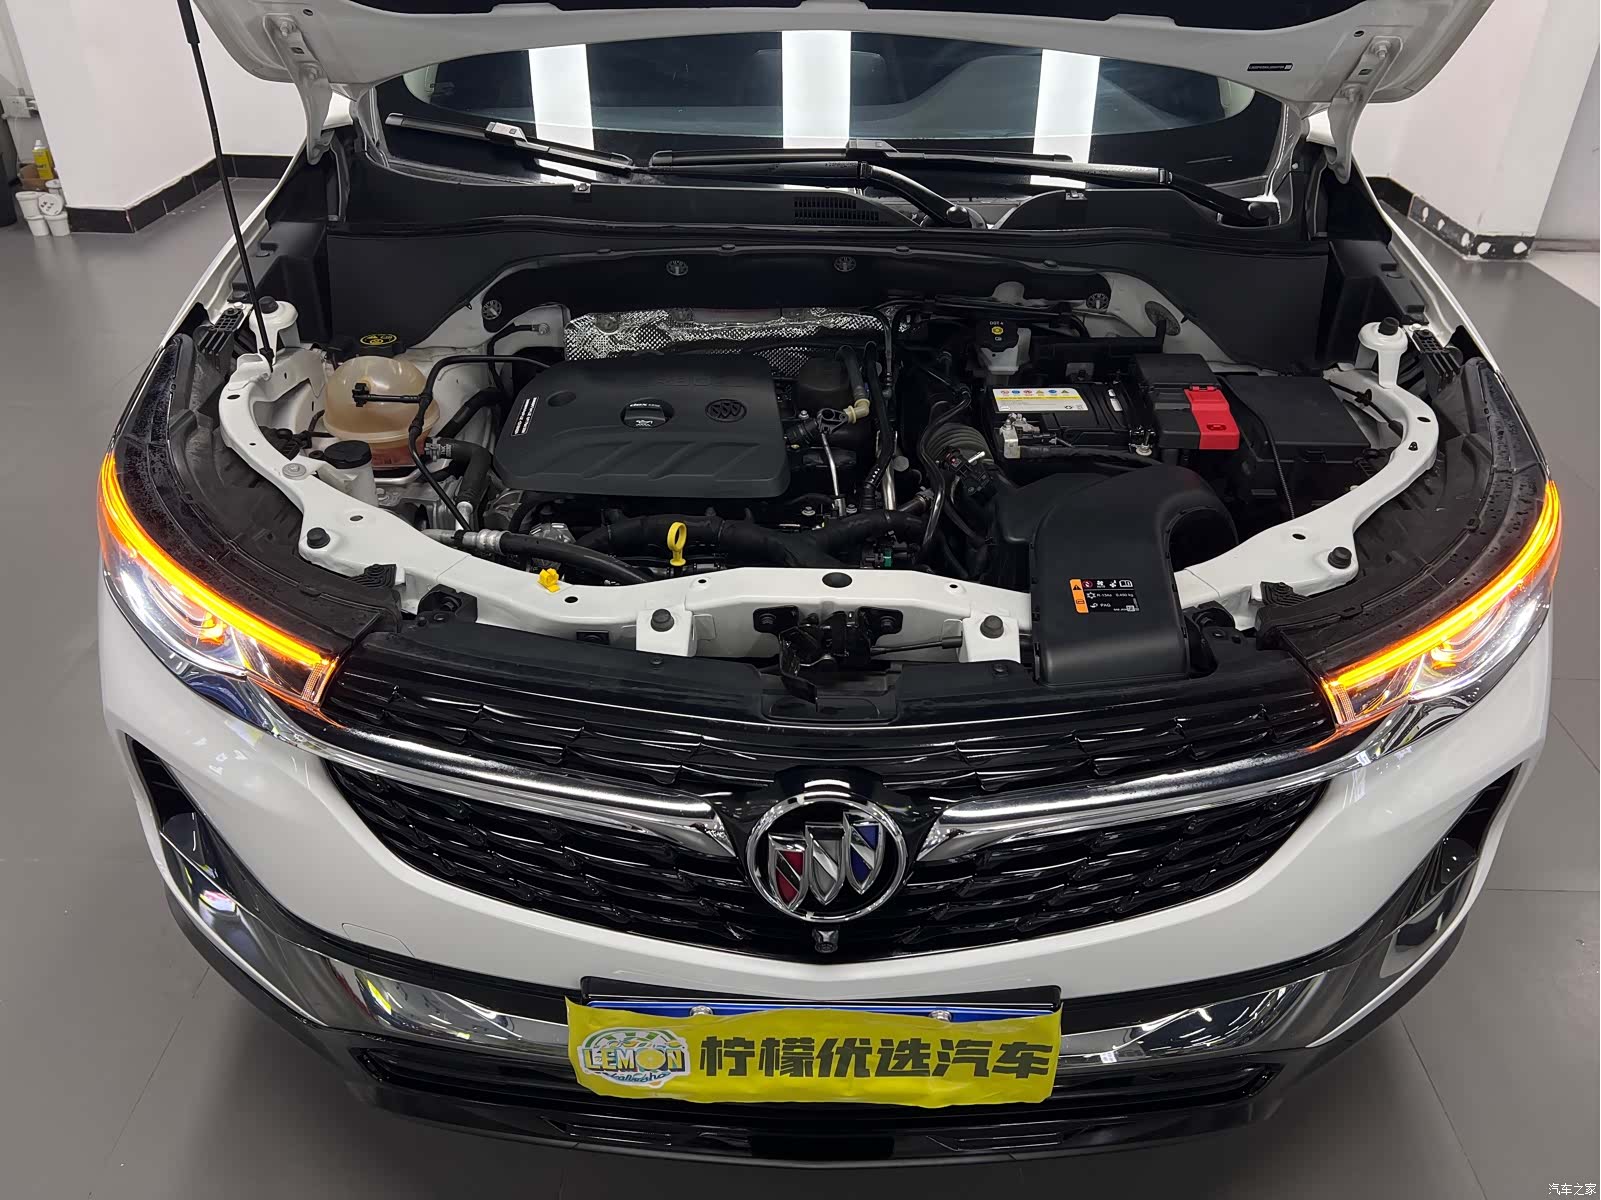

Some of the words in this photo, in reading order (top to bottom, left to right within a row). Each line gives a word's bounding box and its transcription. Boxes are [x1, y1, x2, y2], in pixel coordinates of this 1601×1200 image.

[582, 1047, 686, 1073] LEMON
[700, 1035, 1054, 1079] 柠檬优选汽车
